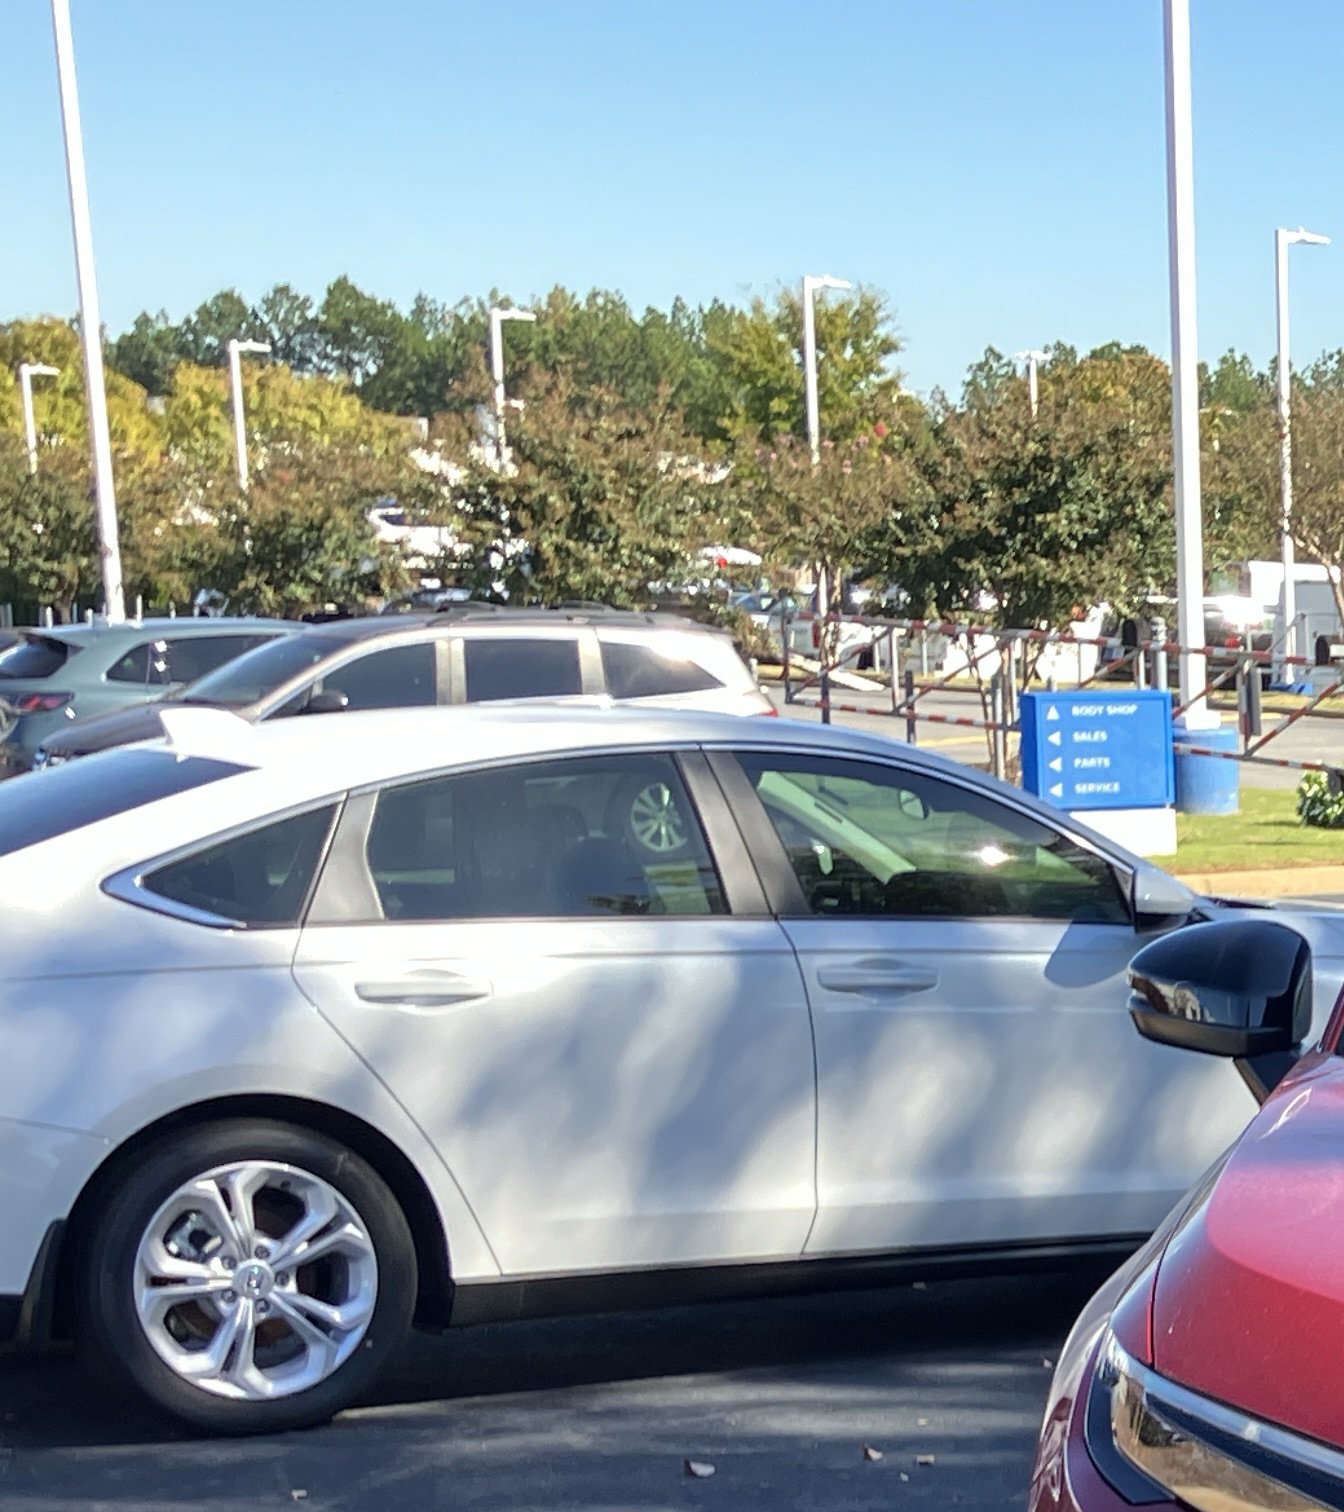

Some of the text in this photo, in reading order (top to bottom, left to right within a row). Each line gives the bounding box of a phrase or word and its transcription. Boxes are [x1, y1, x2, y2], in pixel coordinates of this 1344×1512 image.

[1072, 703, 1138, 717] BODY SHOP
[1073, 730, 1108, 743] SALES
[1074, 756, 1110, 769] PARTS
[1075, 781, 1120, 795] SERVICE
